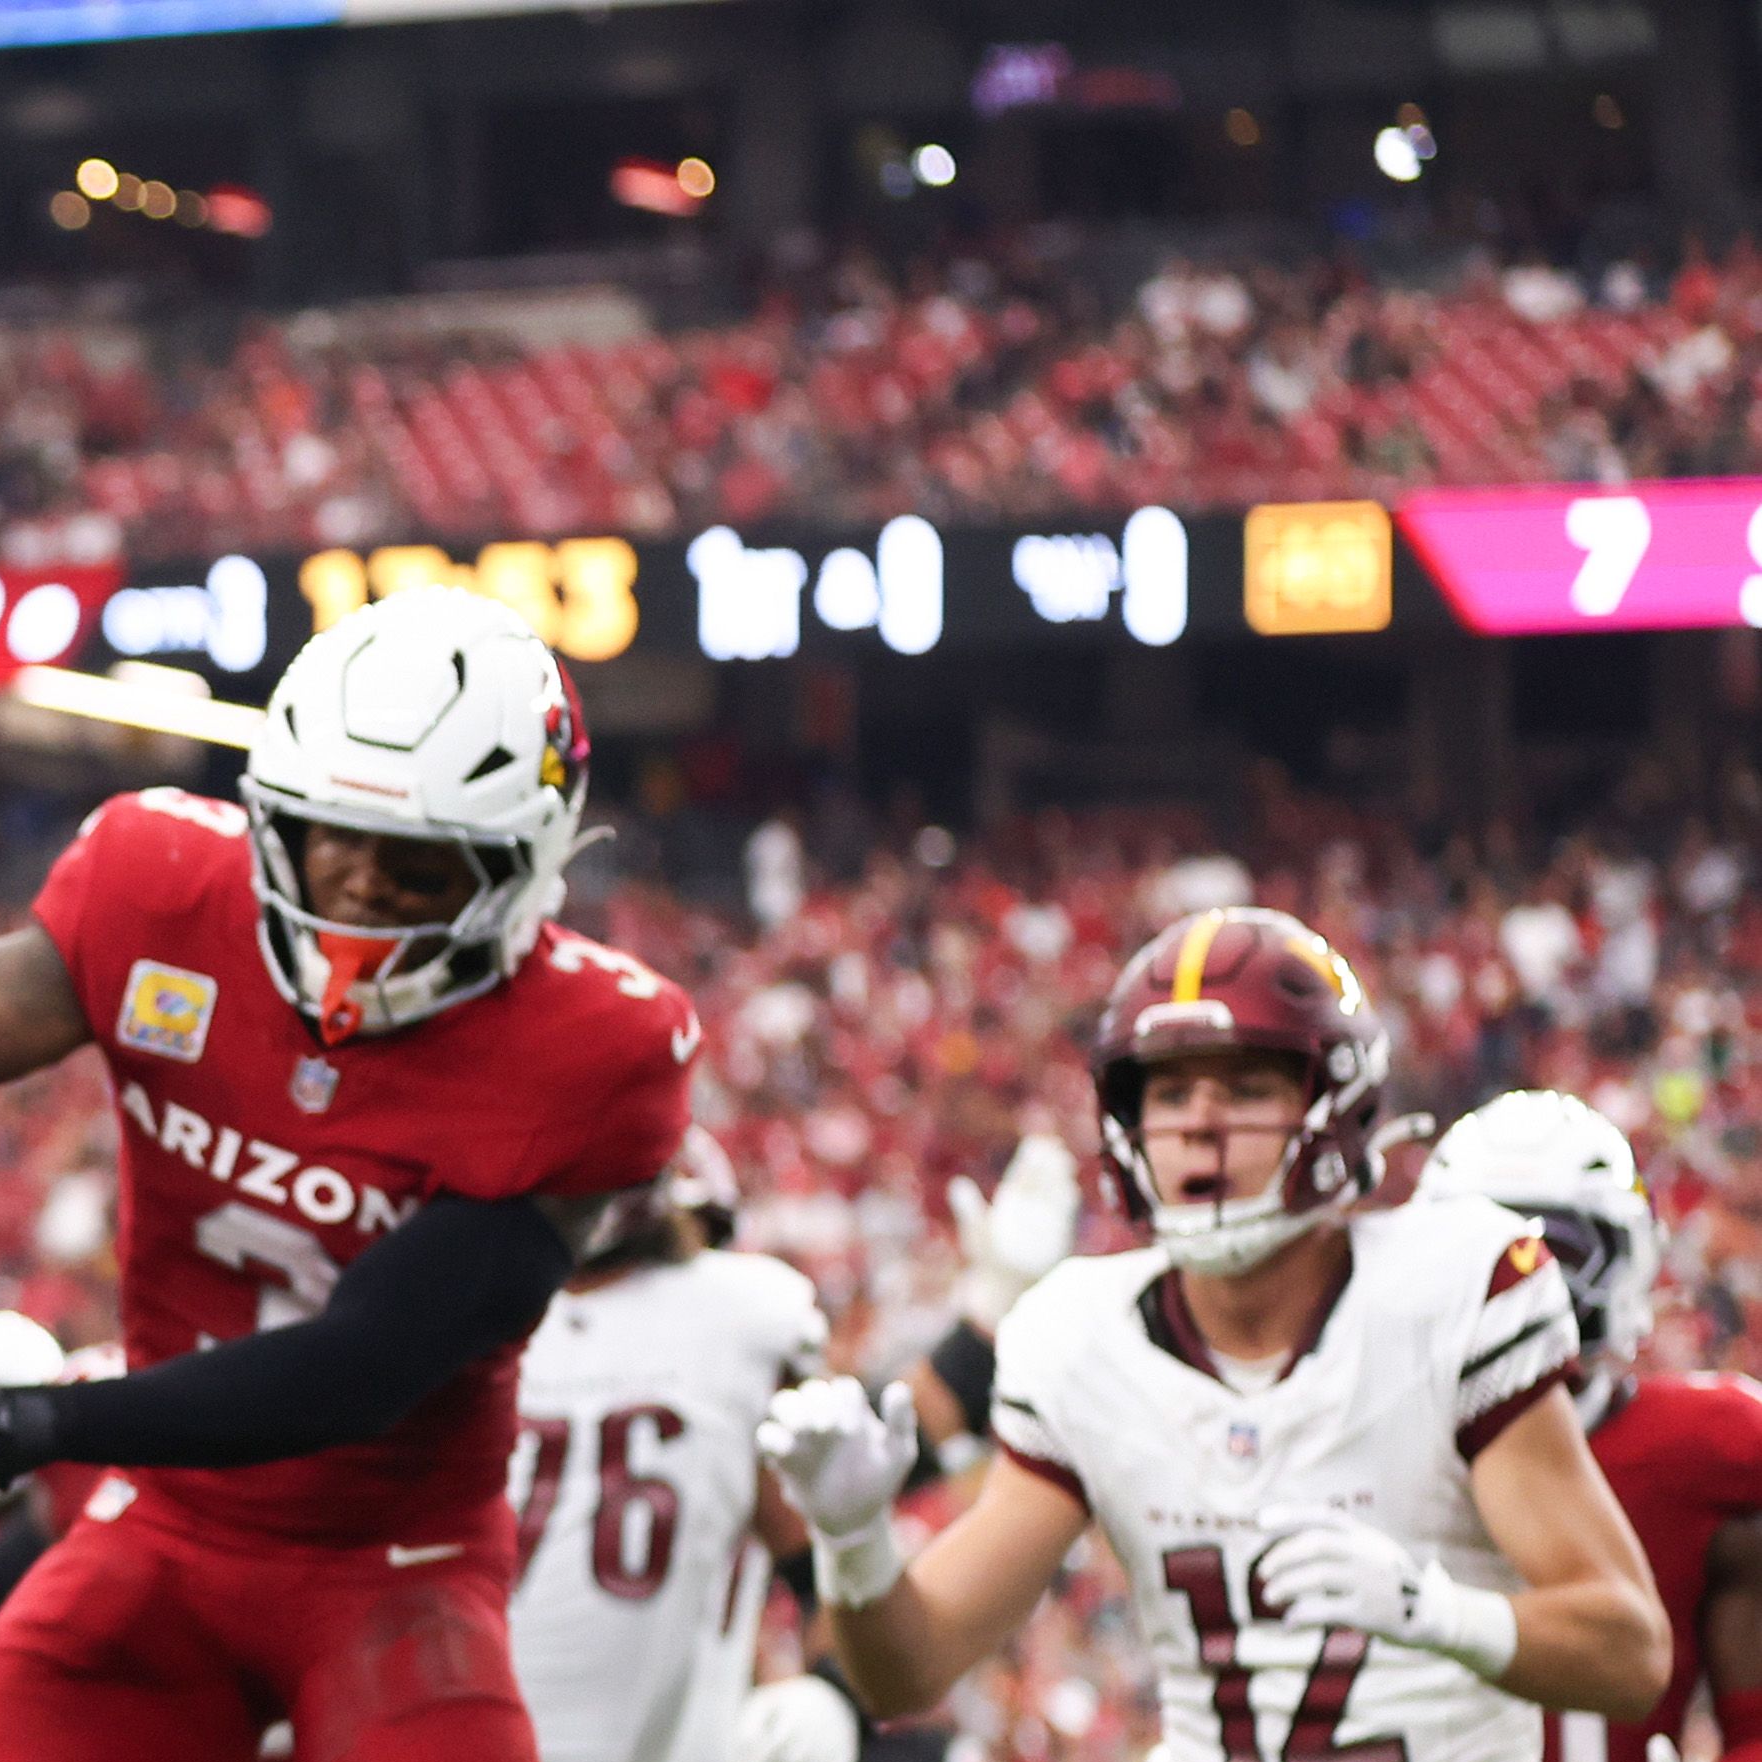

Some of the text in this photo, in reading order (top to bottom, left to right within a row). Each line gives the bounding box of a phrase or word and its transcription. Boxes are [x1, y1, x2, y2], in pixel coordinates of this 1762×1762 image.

[1565, 496, 1652, 617] 7
[120, 1080, 421, 1234] ARIZON
[512, 1402, 686, 1601] 76
